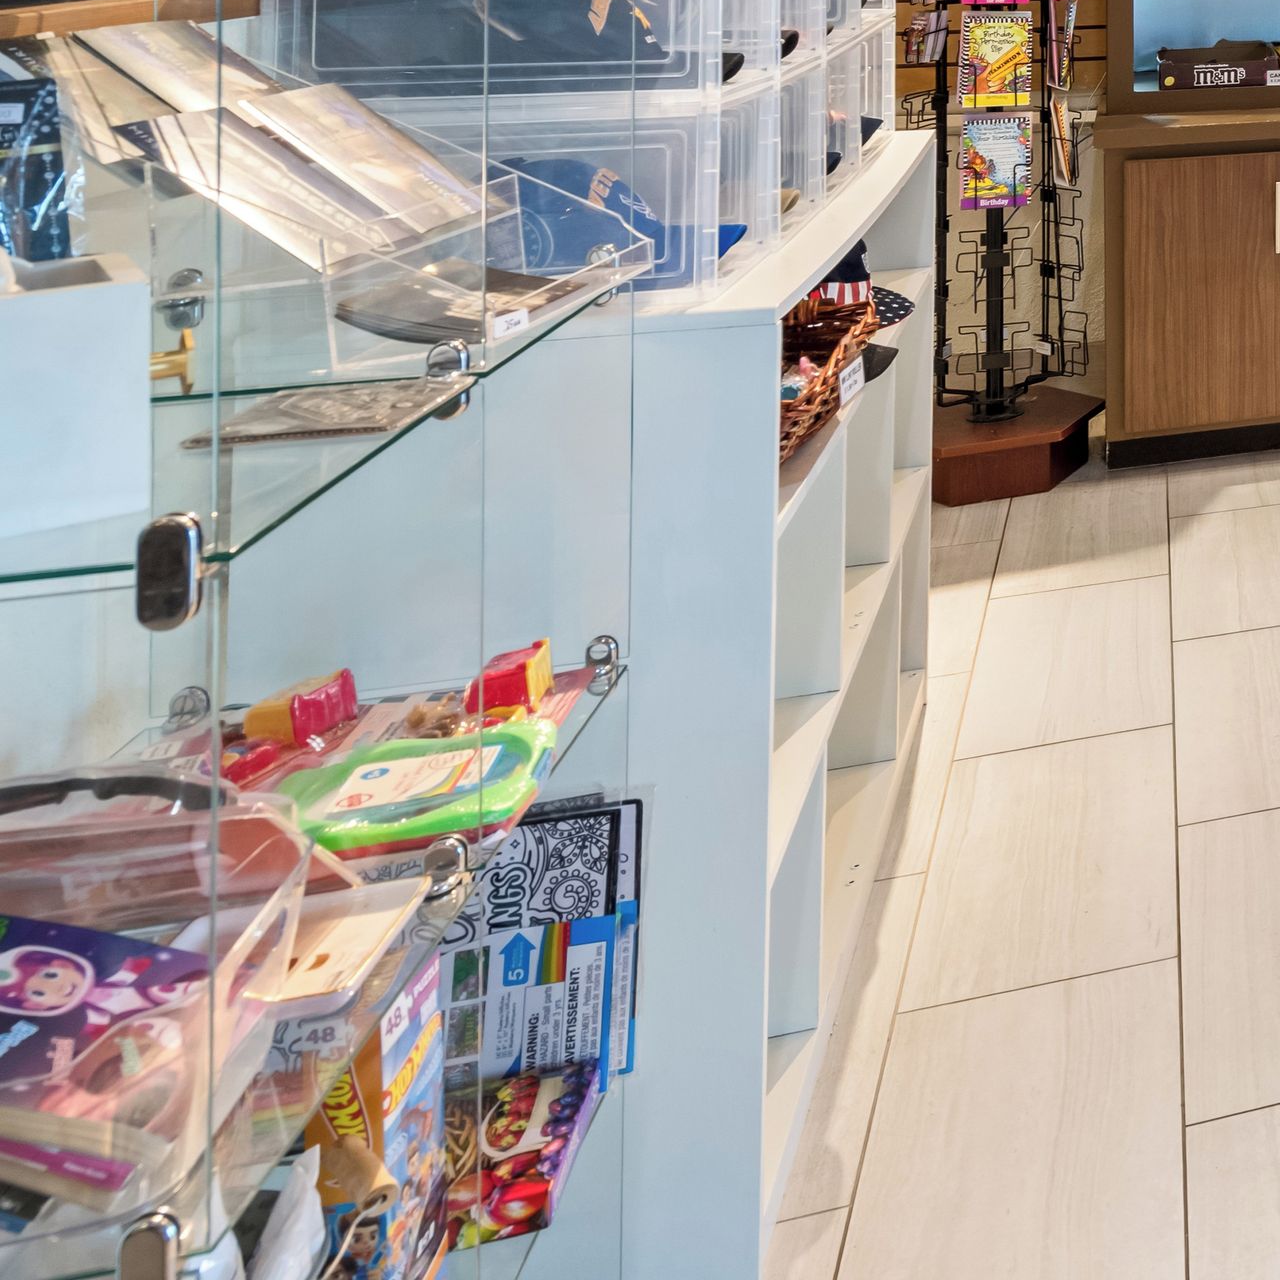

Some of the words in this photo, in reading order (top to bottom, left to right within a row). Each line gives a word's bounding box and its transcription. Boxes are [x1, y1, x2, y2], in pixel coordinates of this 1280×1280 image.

[508, 969, 524, 981] 5
[385, 1007, 402, 1036] 48
[564, 966, 581, 1066] AVERTISSEMENT:
[305, 1027, 336, 1044] 48
[526, 1012, 540, 1072] WARNING:
[540, 1031, 549, 1062] HAZARD
